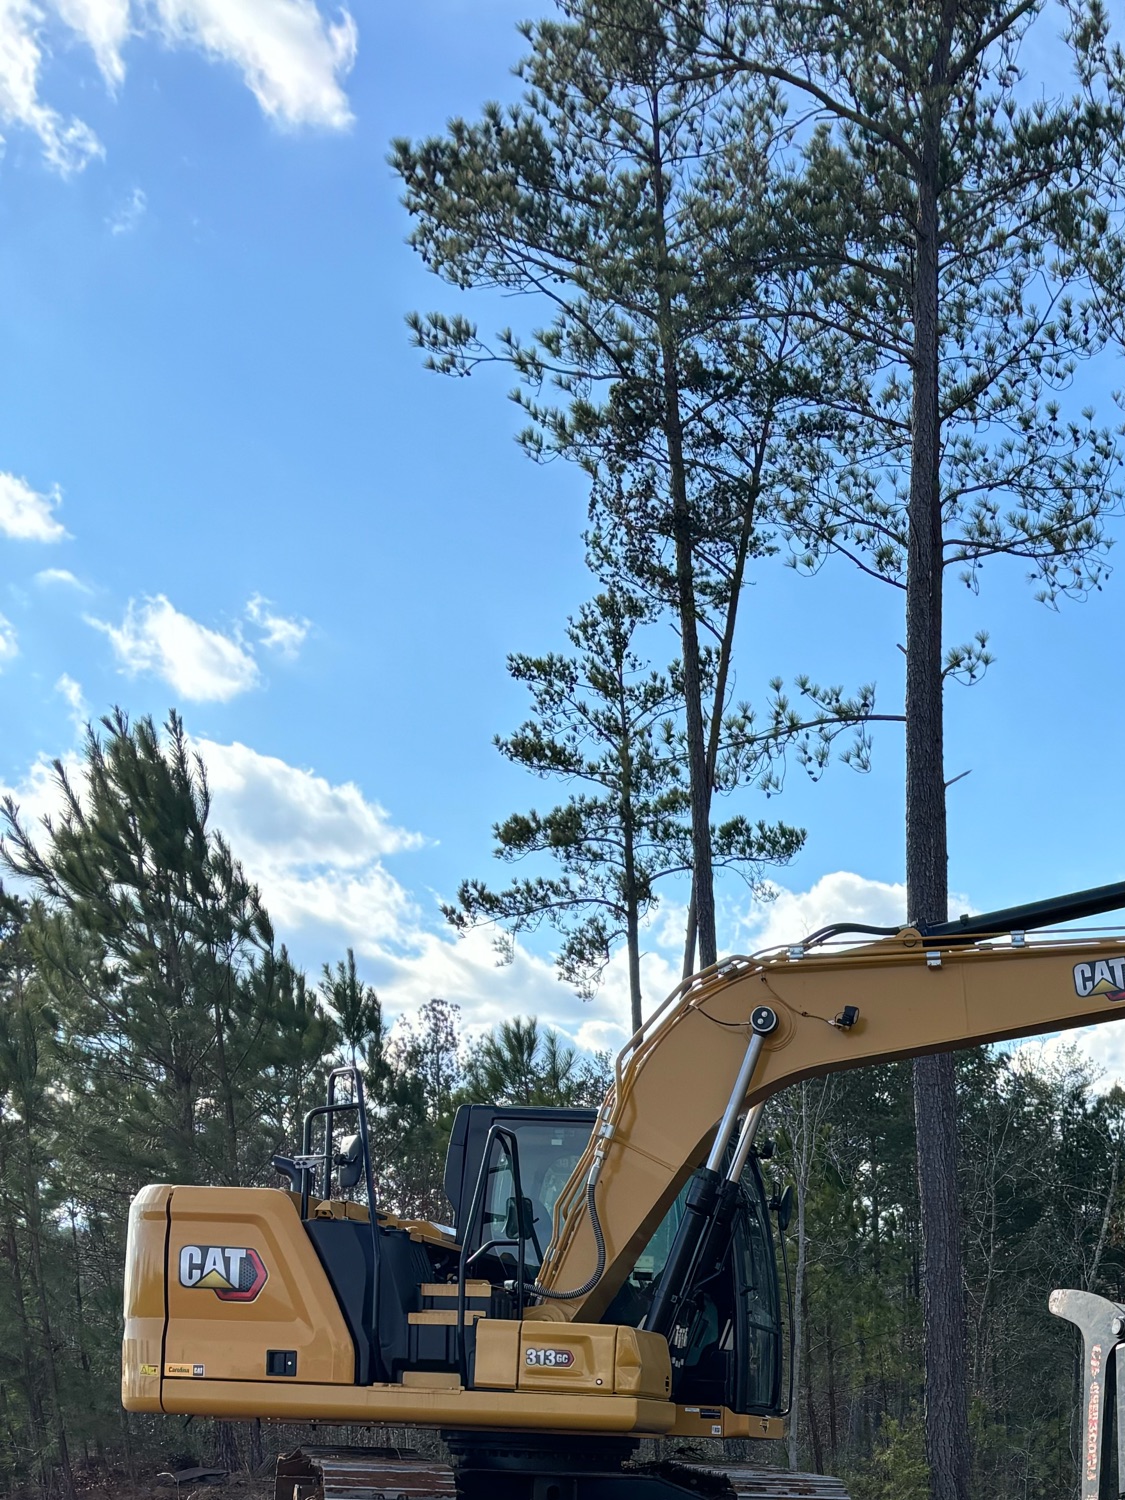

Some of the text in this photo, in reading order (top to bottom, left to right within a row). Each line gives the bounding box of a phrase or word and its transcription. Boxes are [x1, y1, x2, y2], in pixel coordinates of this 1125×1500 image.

[1074, 957, 1125, 996] CAT
[180, 1245, 247, 1289] CAT
[526, 1348, 569, 1366] 313 GC
